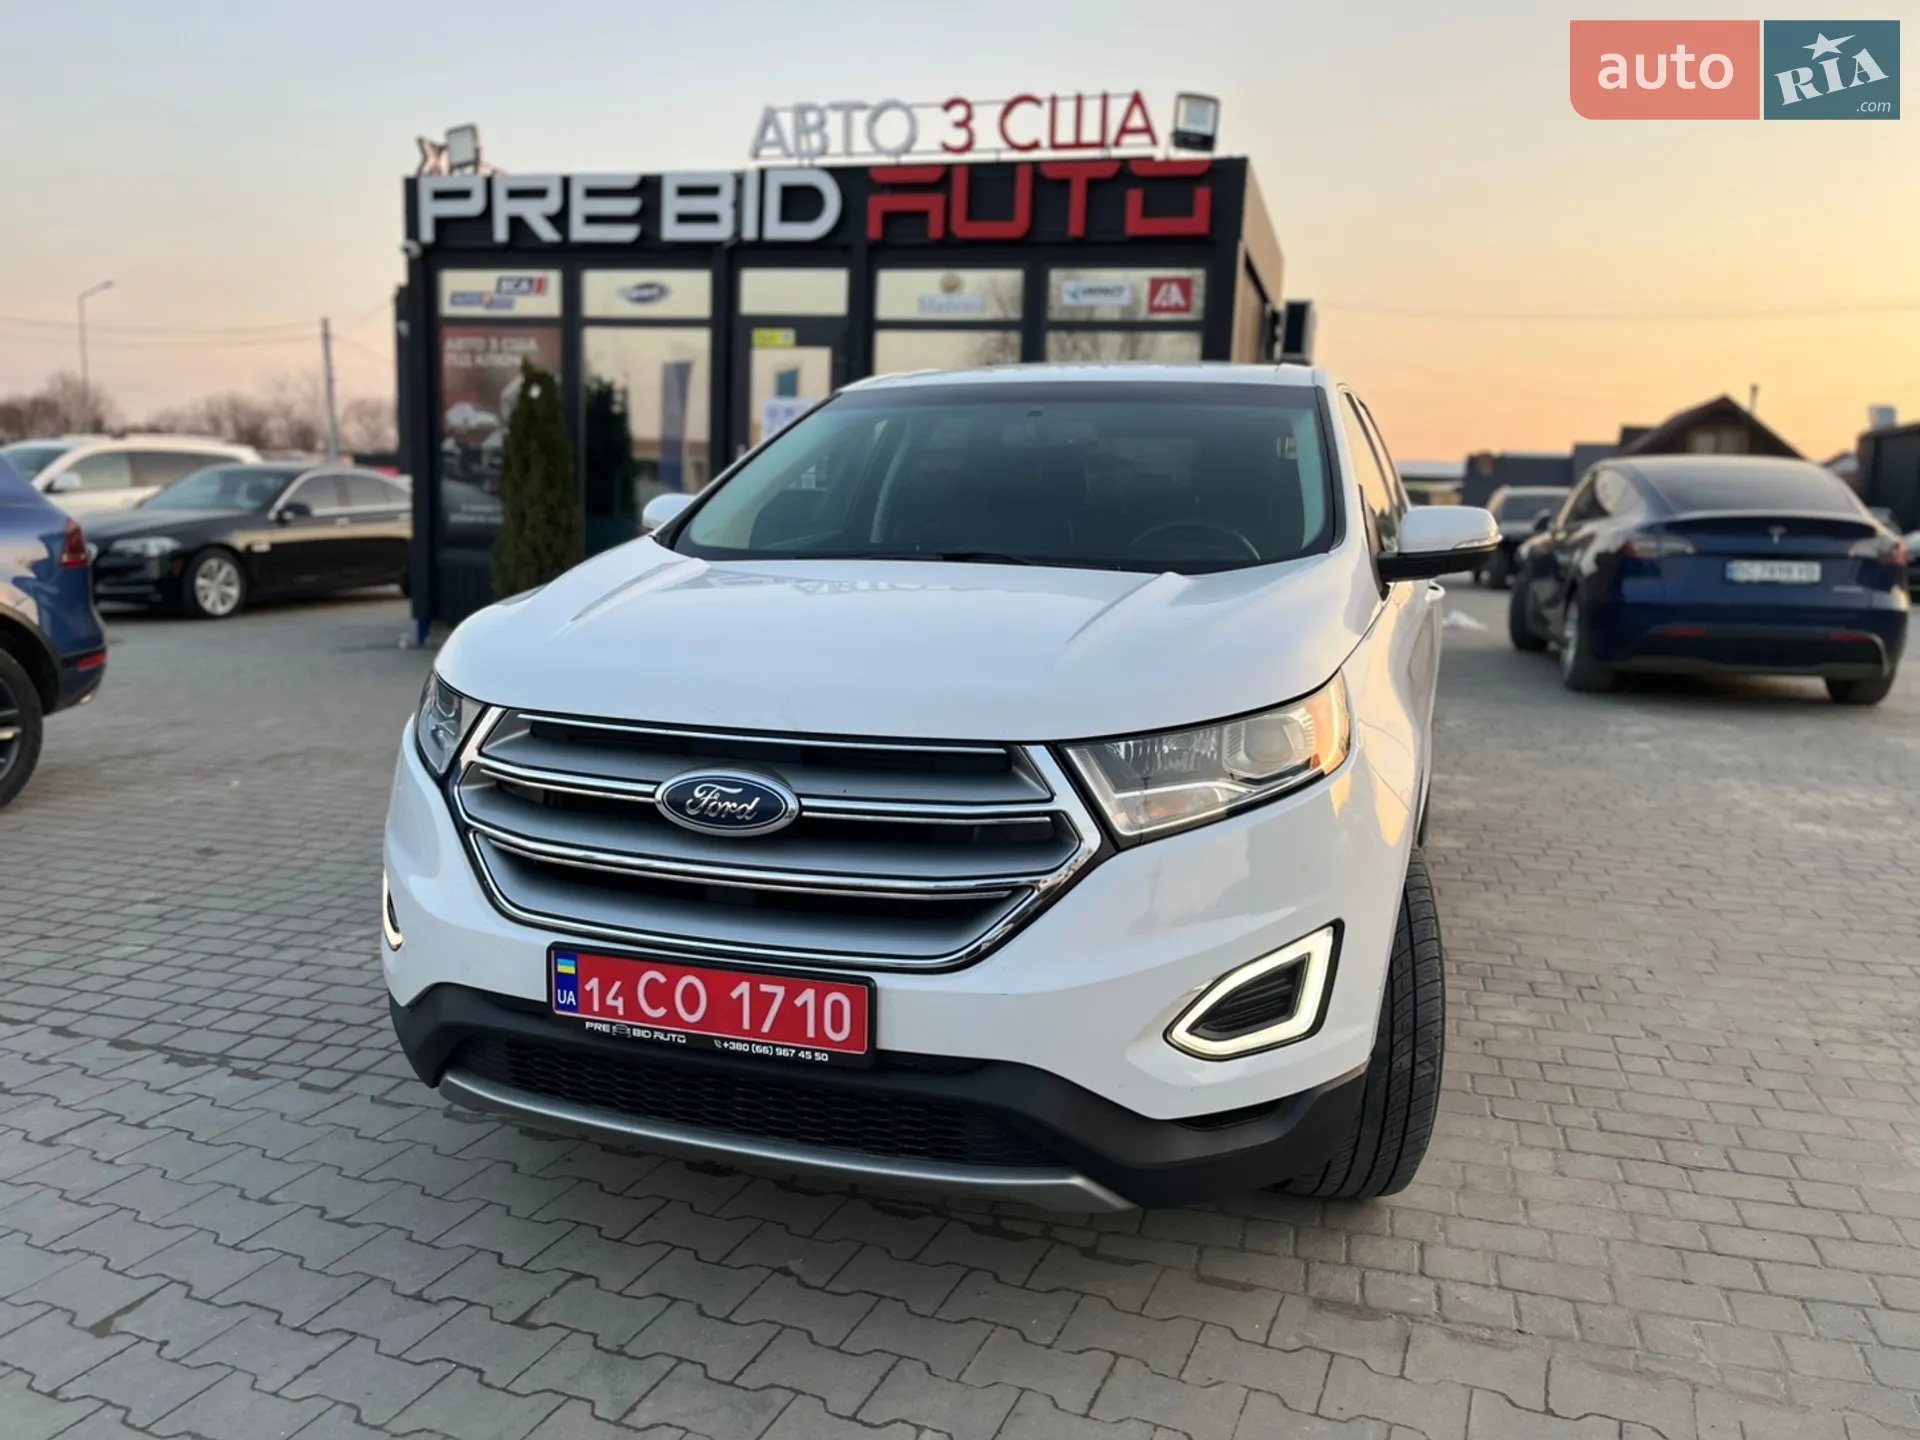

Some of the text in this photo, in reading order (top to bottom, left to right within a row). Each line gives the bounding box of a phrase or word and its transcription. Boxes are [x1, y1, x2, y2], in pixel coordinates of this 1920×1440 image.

[749, 99, 918, 159] АВТО
[999, 89, 1158, 152] США
[416, 157, 1213, 244] PRE BID AUTO
[685, 783, 761, 820] Ford
[557, 989, 576, 1006] UA
[584, 970, 851, 1042] 14 CO 1710
[585, 1021, 687, 1044] PRE BID AUTO
[722, 1041, 828, 1062] +380 (66) 967 45 50
